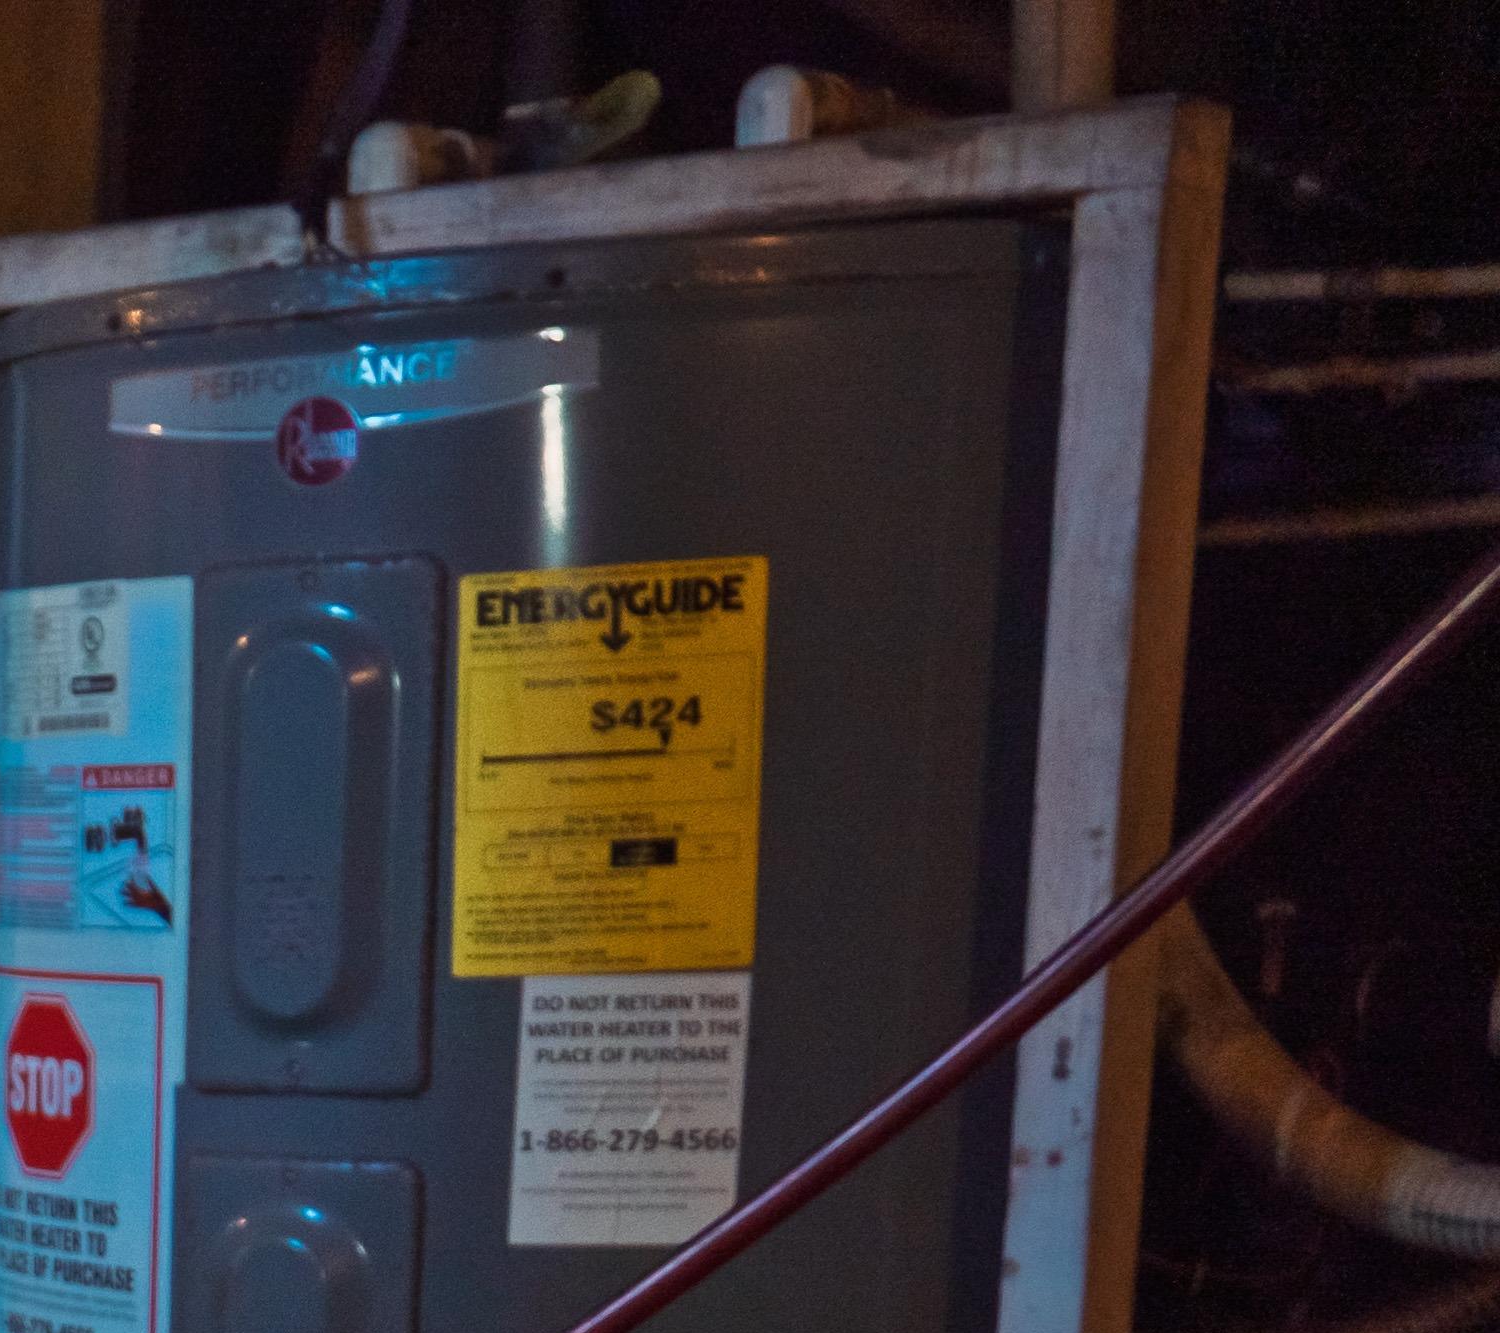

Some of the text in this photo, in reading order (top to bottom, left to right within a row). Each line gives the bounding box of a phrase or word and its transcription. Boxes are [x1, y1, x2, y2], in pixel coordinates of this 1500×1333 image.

[476, 575, 745, 628] ENERGYGUIDE
[9, 1052, 85, 1118] STOP
[520, 1127, 738, 1152] 1-866-279-4566
[26, 1191, 78, 1221] RETURN
[83, 1199, 120, 1227] THIS
[87, 1230, 108, 1258] TO
[52, 1257, 137, 1293] PURCHASE
